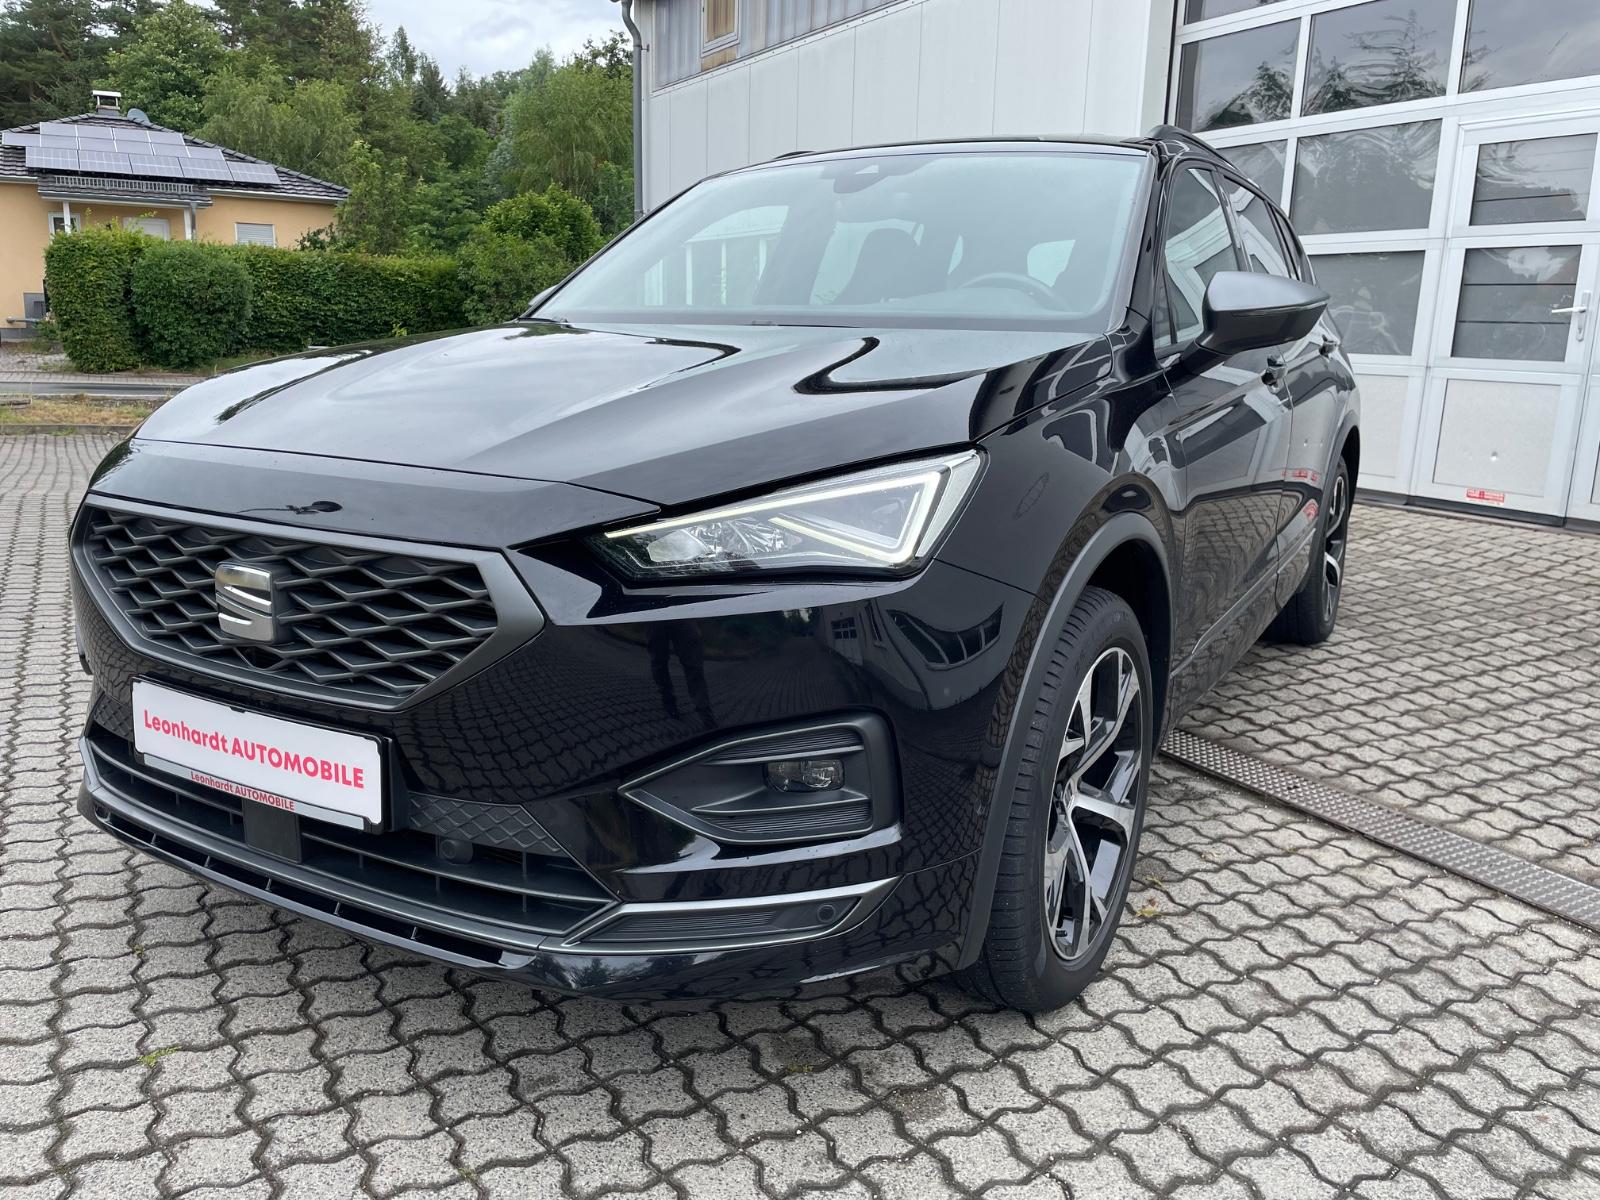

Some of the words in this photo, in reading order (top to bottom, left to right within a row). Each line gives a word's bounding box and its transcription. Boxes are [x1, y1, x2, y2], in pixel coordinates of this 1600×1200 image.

[143, 709, 229, 753] Leonhardt
[231, 737, 365, 789] AUTOMOBILE
[190, 771, 234, 793] Leonhardt
[234, 785, 296, 811] AUTOMOBILE
